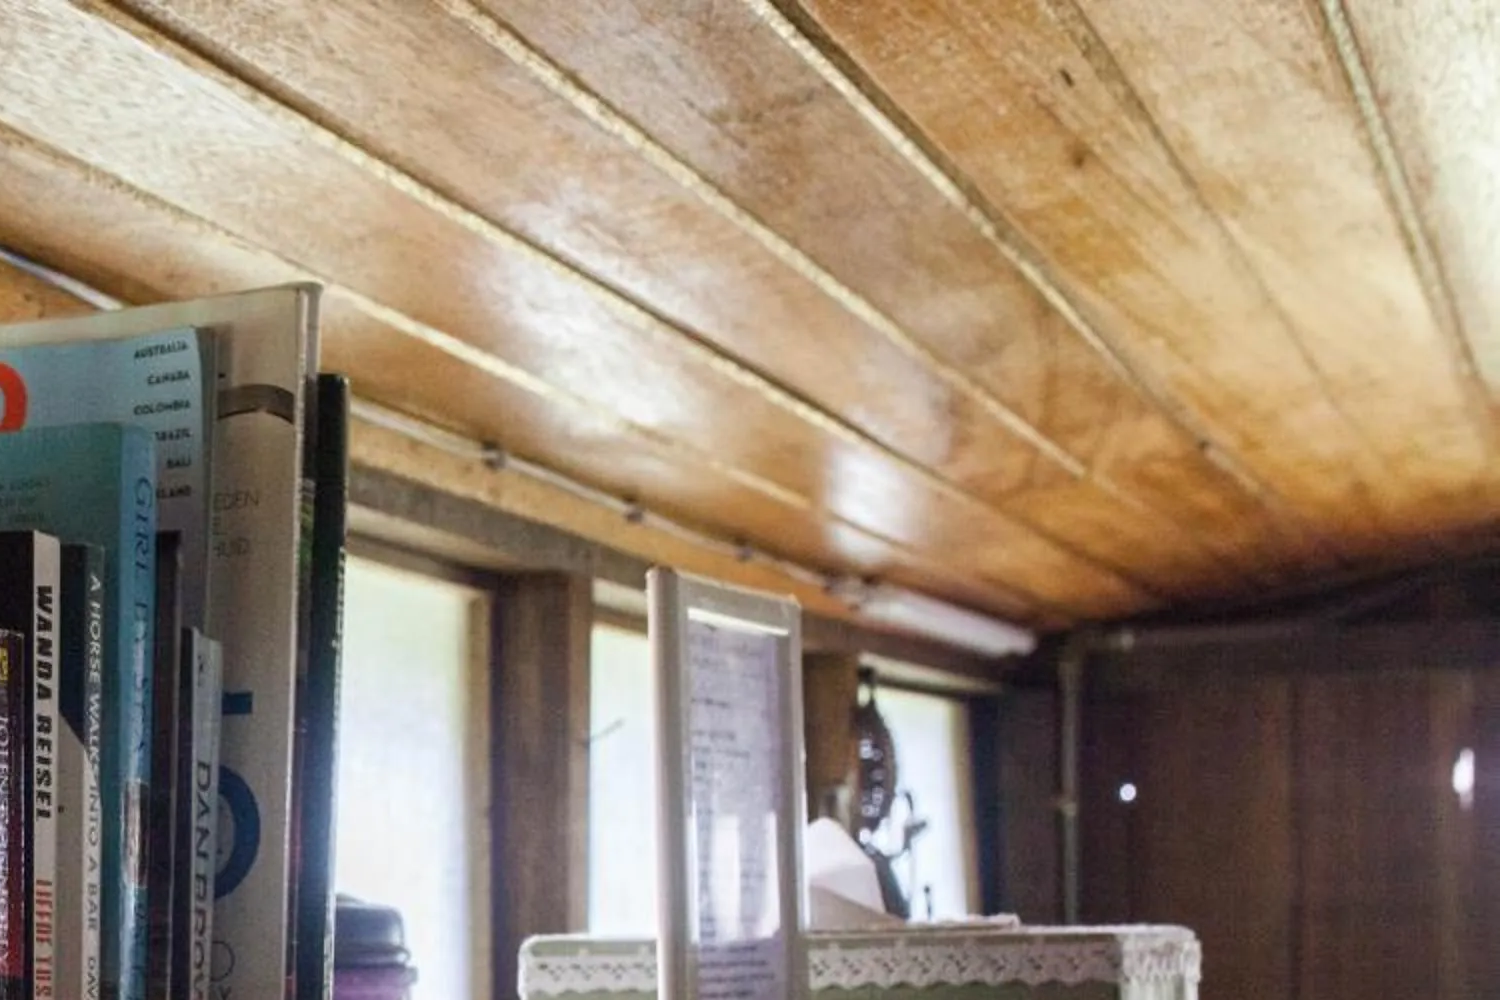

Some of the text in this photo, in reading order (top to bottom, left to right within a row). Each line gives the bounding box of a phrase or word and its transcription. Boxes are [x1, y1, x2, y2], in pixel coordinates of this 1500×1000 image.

[133, 343, 188, 360] AUSTRALIA
[146, 370, 191, 385] CANADA
[133, 400, 192, 416] COLOMBIA
[89, 600, 102, 684] HORSE
[36, 585, 53, 823] WANDA REISEL
[196, 760, 214, 860] DAN
[87, 882, 99, 932] BAR
